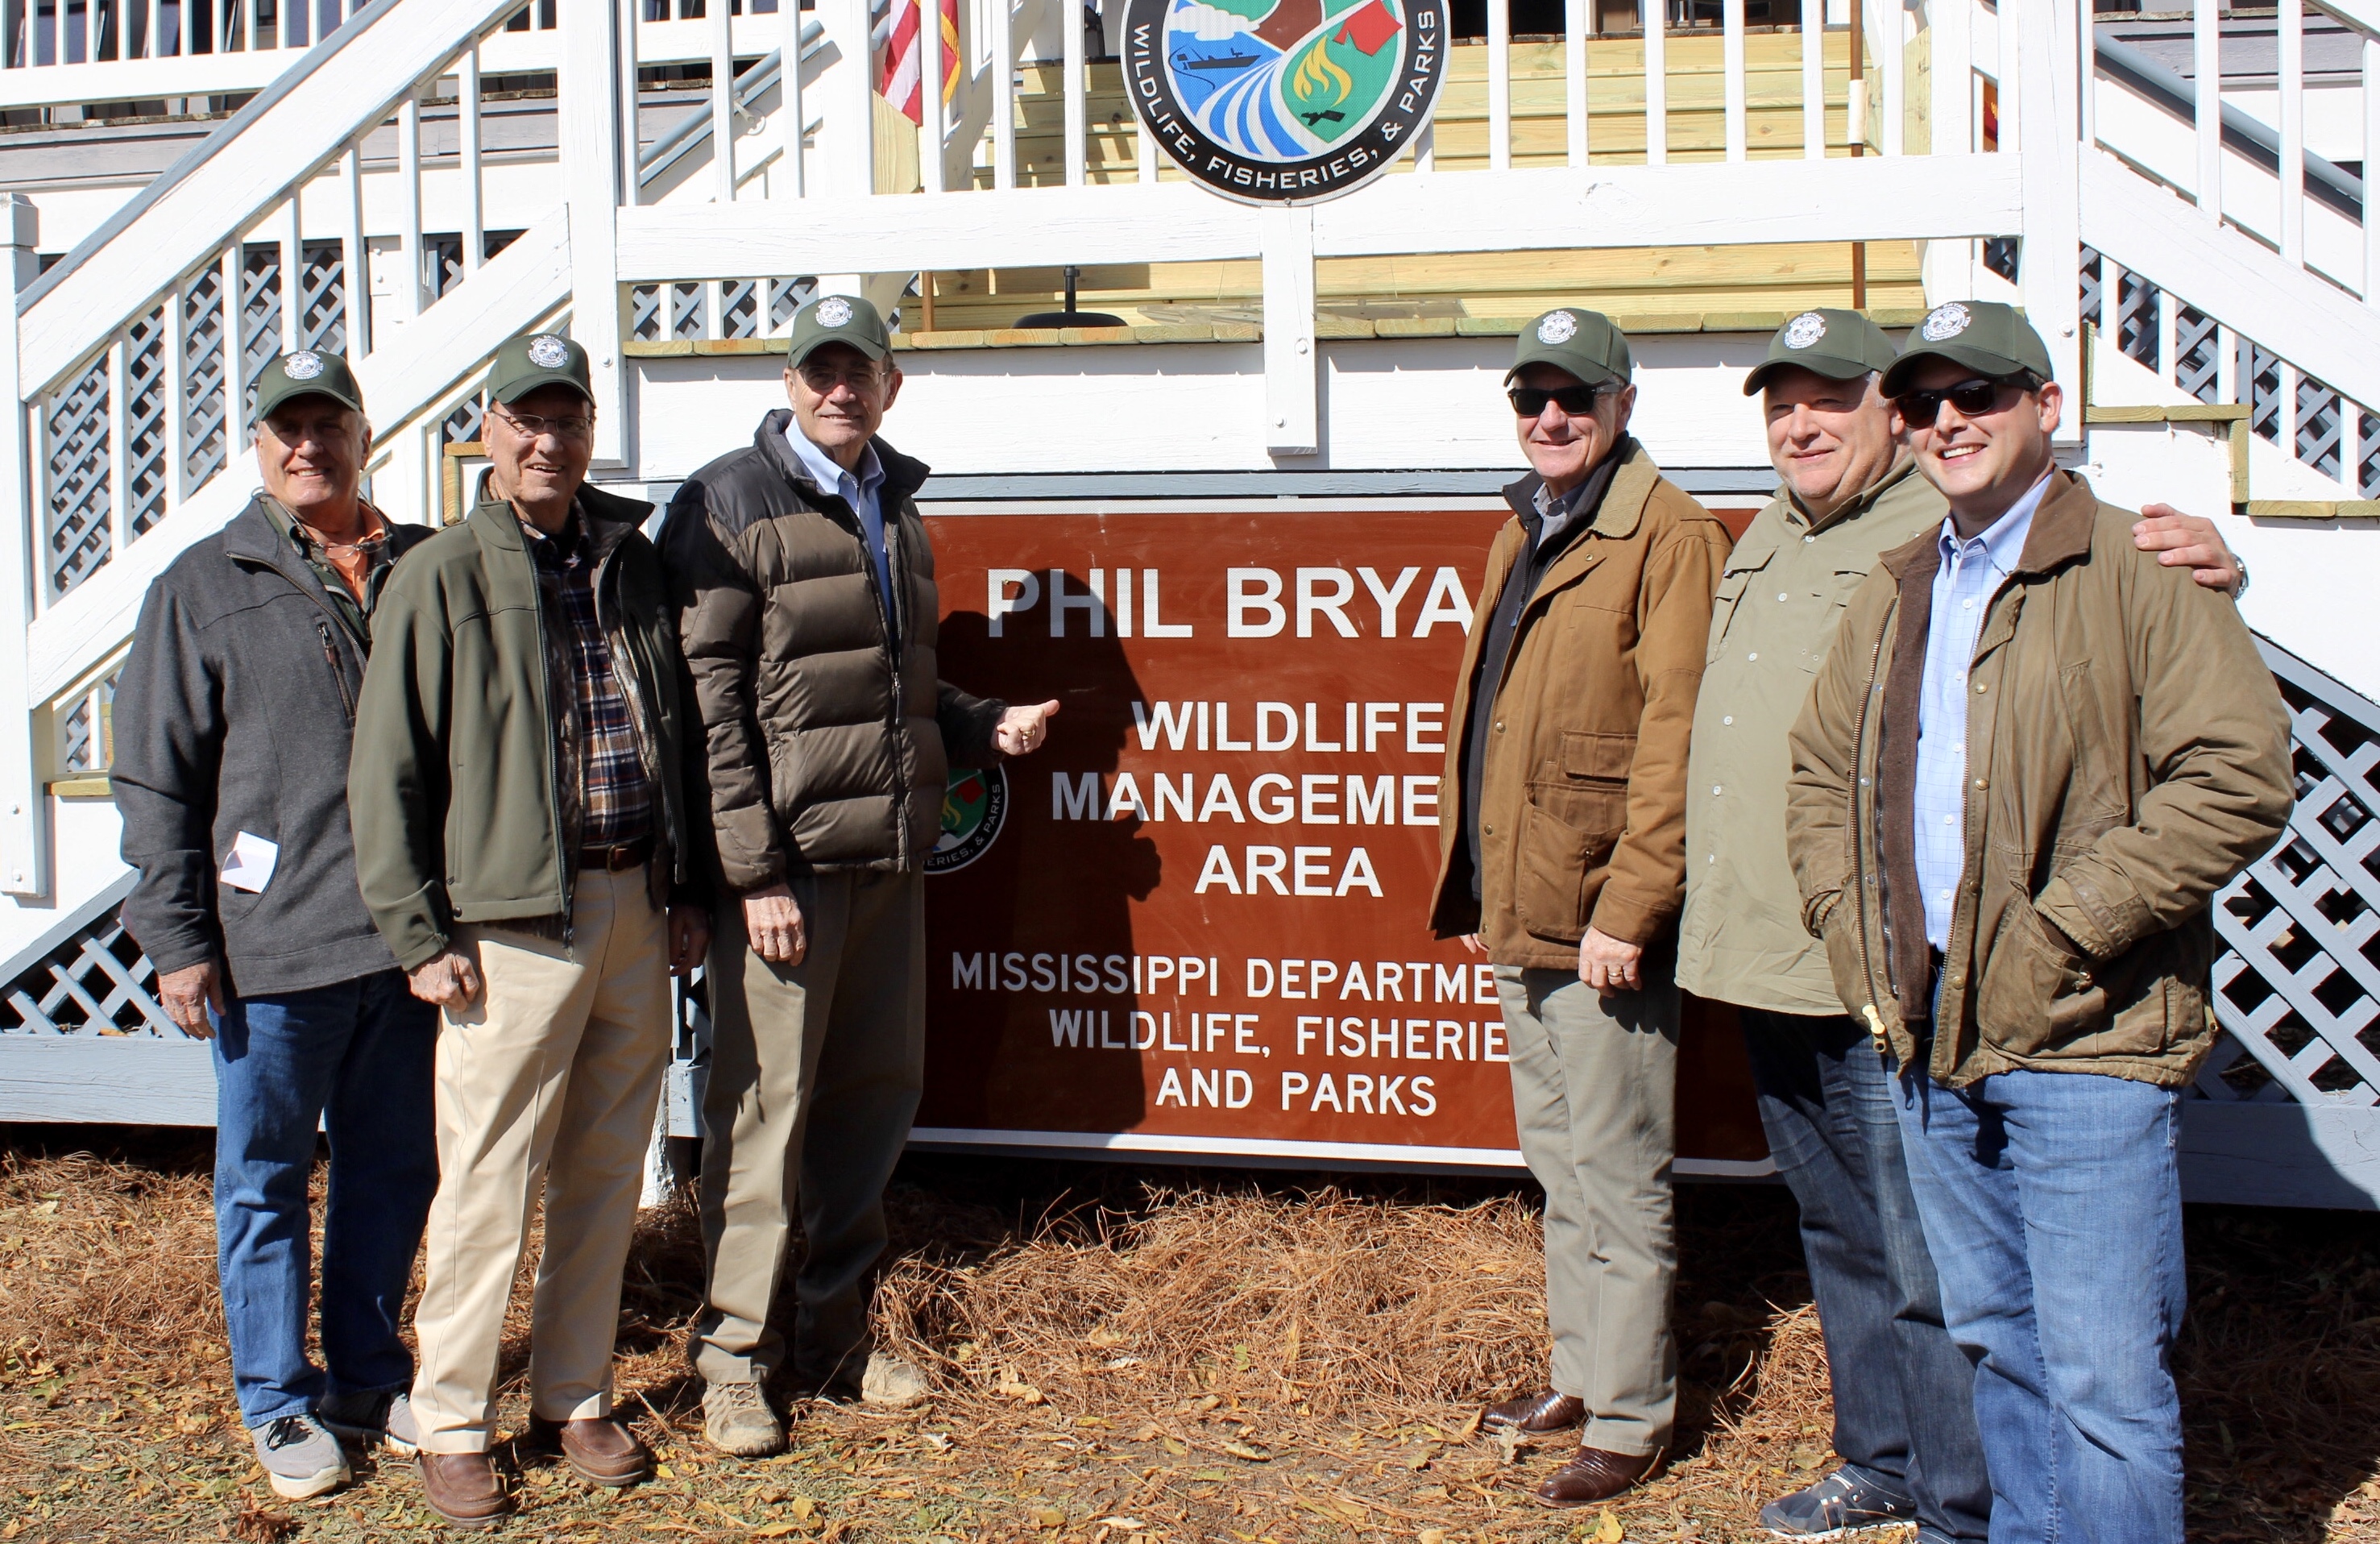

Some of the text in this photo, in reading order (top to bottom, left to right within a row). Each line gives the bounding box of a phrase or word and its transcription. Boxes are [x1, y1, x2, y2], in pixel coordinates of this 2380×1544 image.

[1133, 10, 1436, 189] WILDLIFE, FISHERIES, & PARKS
[988, 567, 1193, 638] PHIL
[1131, 701, 1446, 753] WILDLIFE
[923, 783, 1001, 867] ERIES, & PARKS
[1194, 845, 1383, 897] AREA
[953, 953, 1218, 998] MISSISSIPPI
[1050, 1009, 1509, 1062] WILDLIFE, FISHERIE
[1155, 1068, 1437, 1117] AND PARKS
